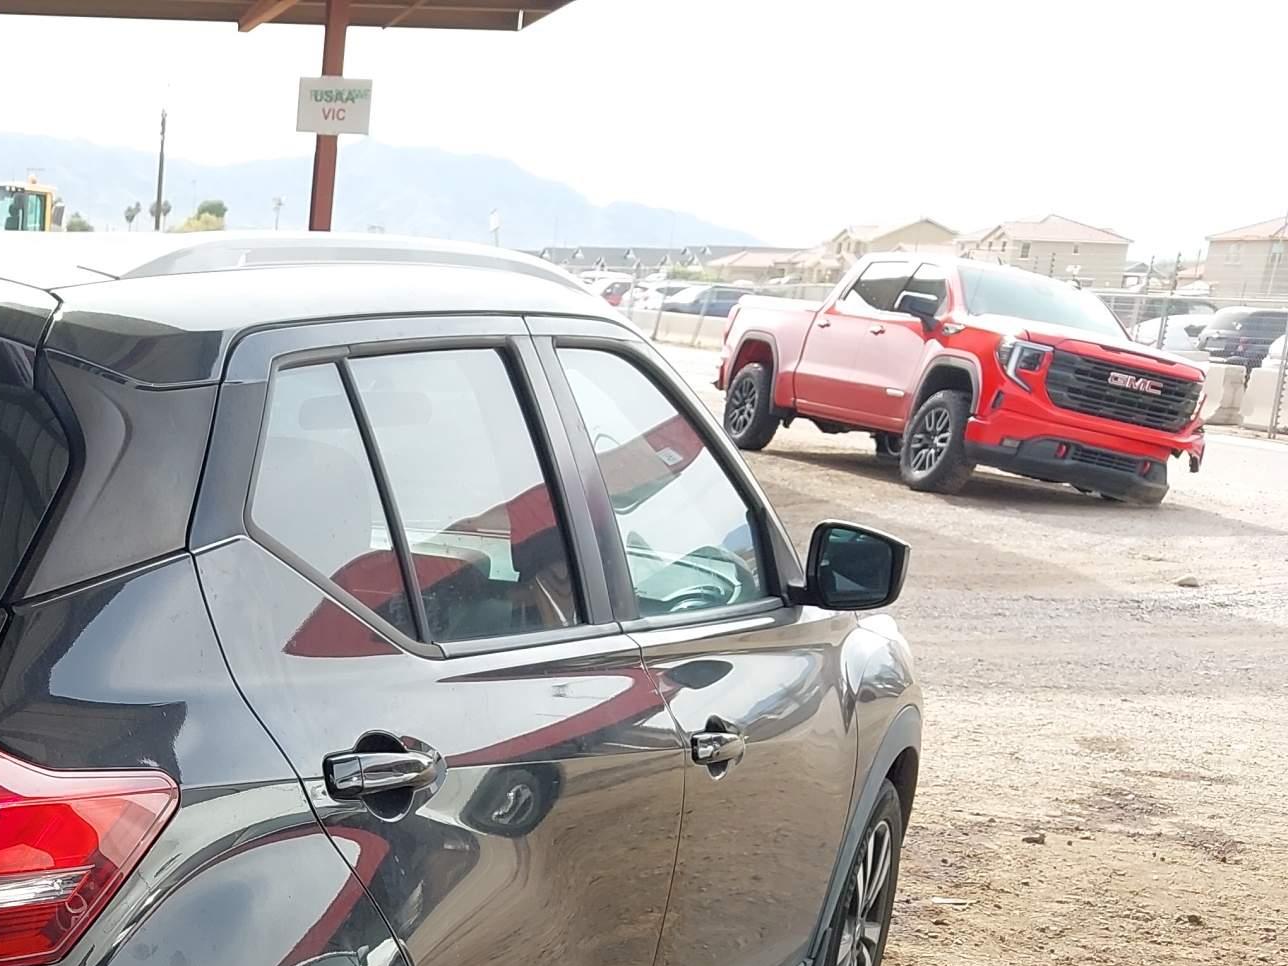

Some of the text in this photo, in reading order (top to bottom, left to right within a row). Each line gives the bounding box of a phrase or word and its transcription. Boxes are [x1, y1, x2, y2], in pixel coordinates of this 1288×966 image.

[313, 89, 355, 104] USAA
[322, 108, 346, 121] VIC
[1108, 372, 1163, 395] GMC
